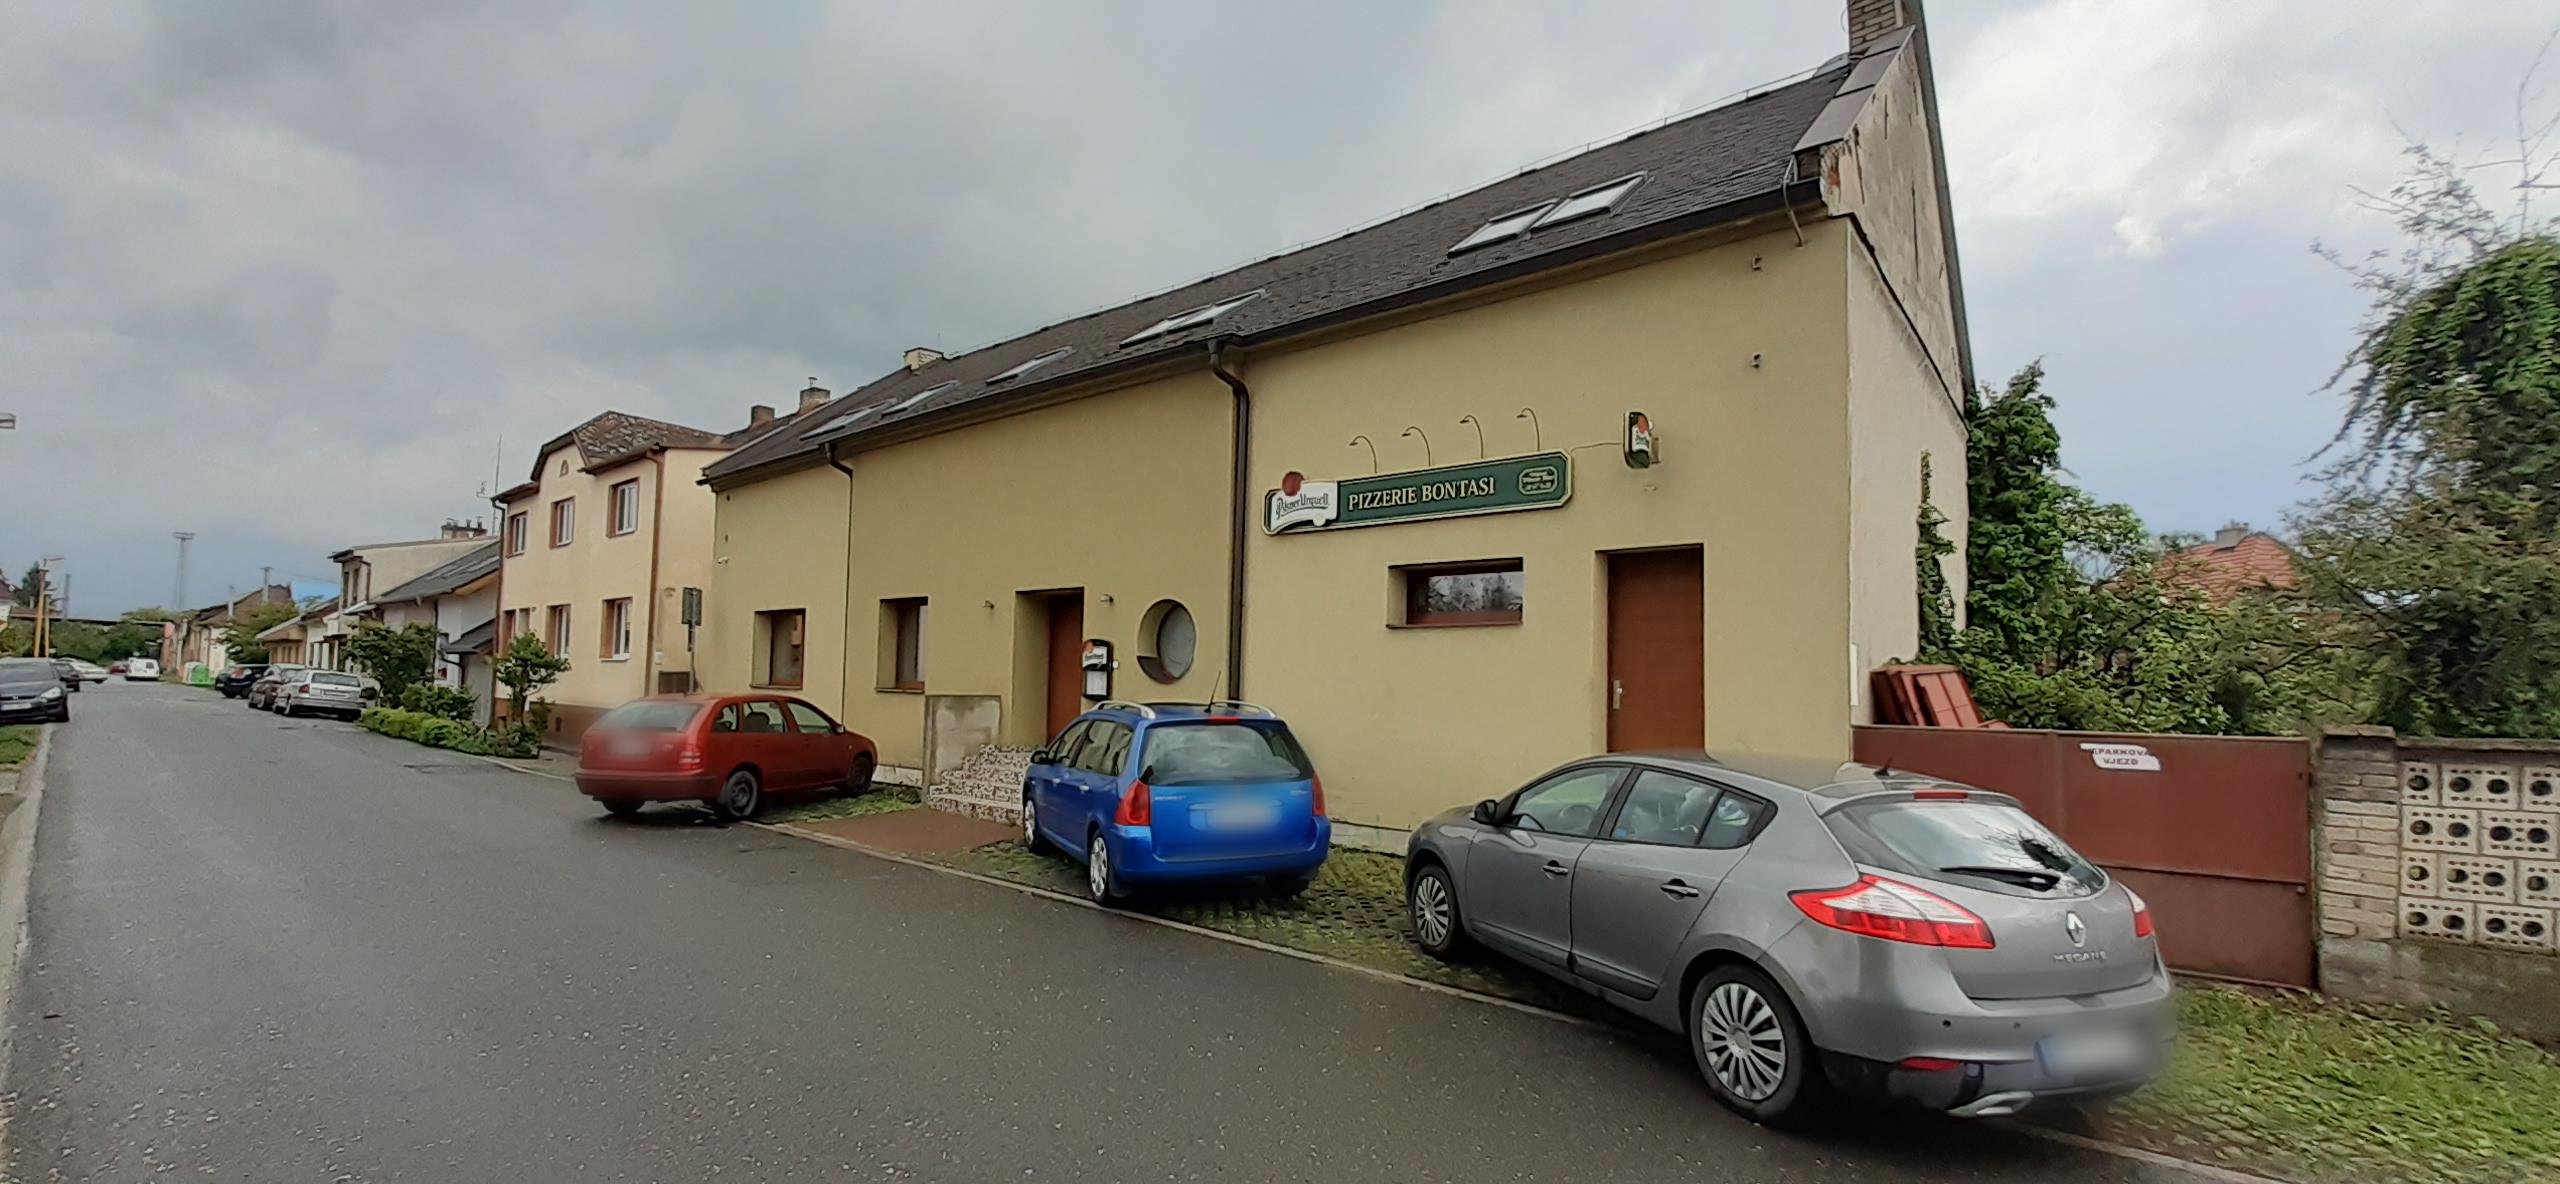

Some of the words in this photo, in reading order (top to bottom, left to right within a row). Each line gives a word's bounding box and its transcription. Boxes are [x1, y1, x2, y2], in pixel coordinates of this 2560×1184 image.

[1348, 486, 1418, 511] PIZZERIE
[1422, 477, 1495, 502] BONTASI
[2103, 757, 2139, 765] VJEZD
[2053, 949, 2107, 962] MEGANE
